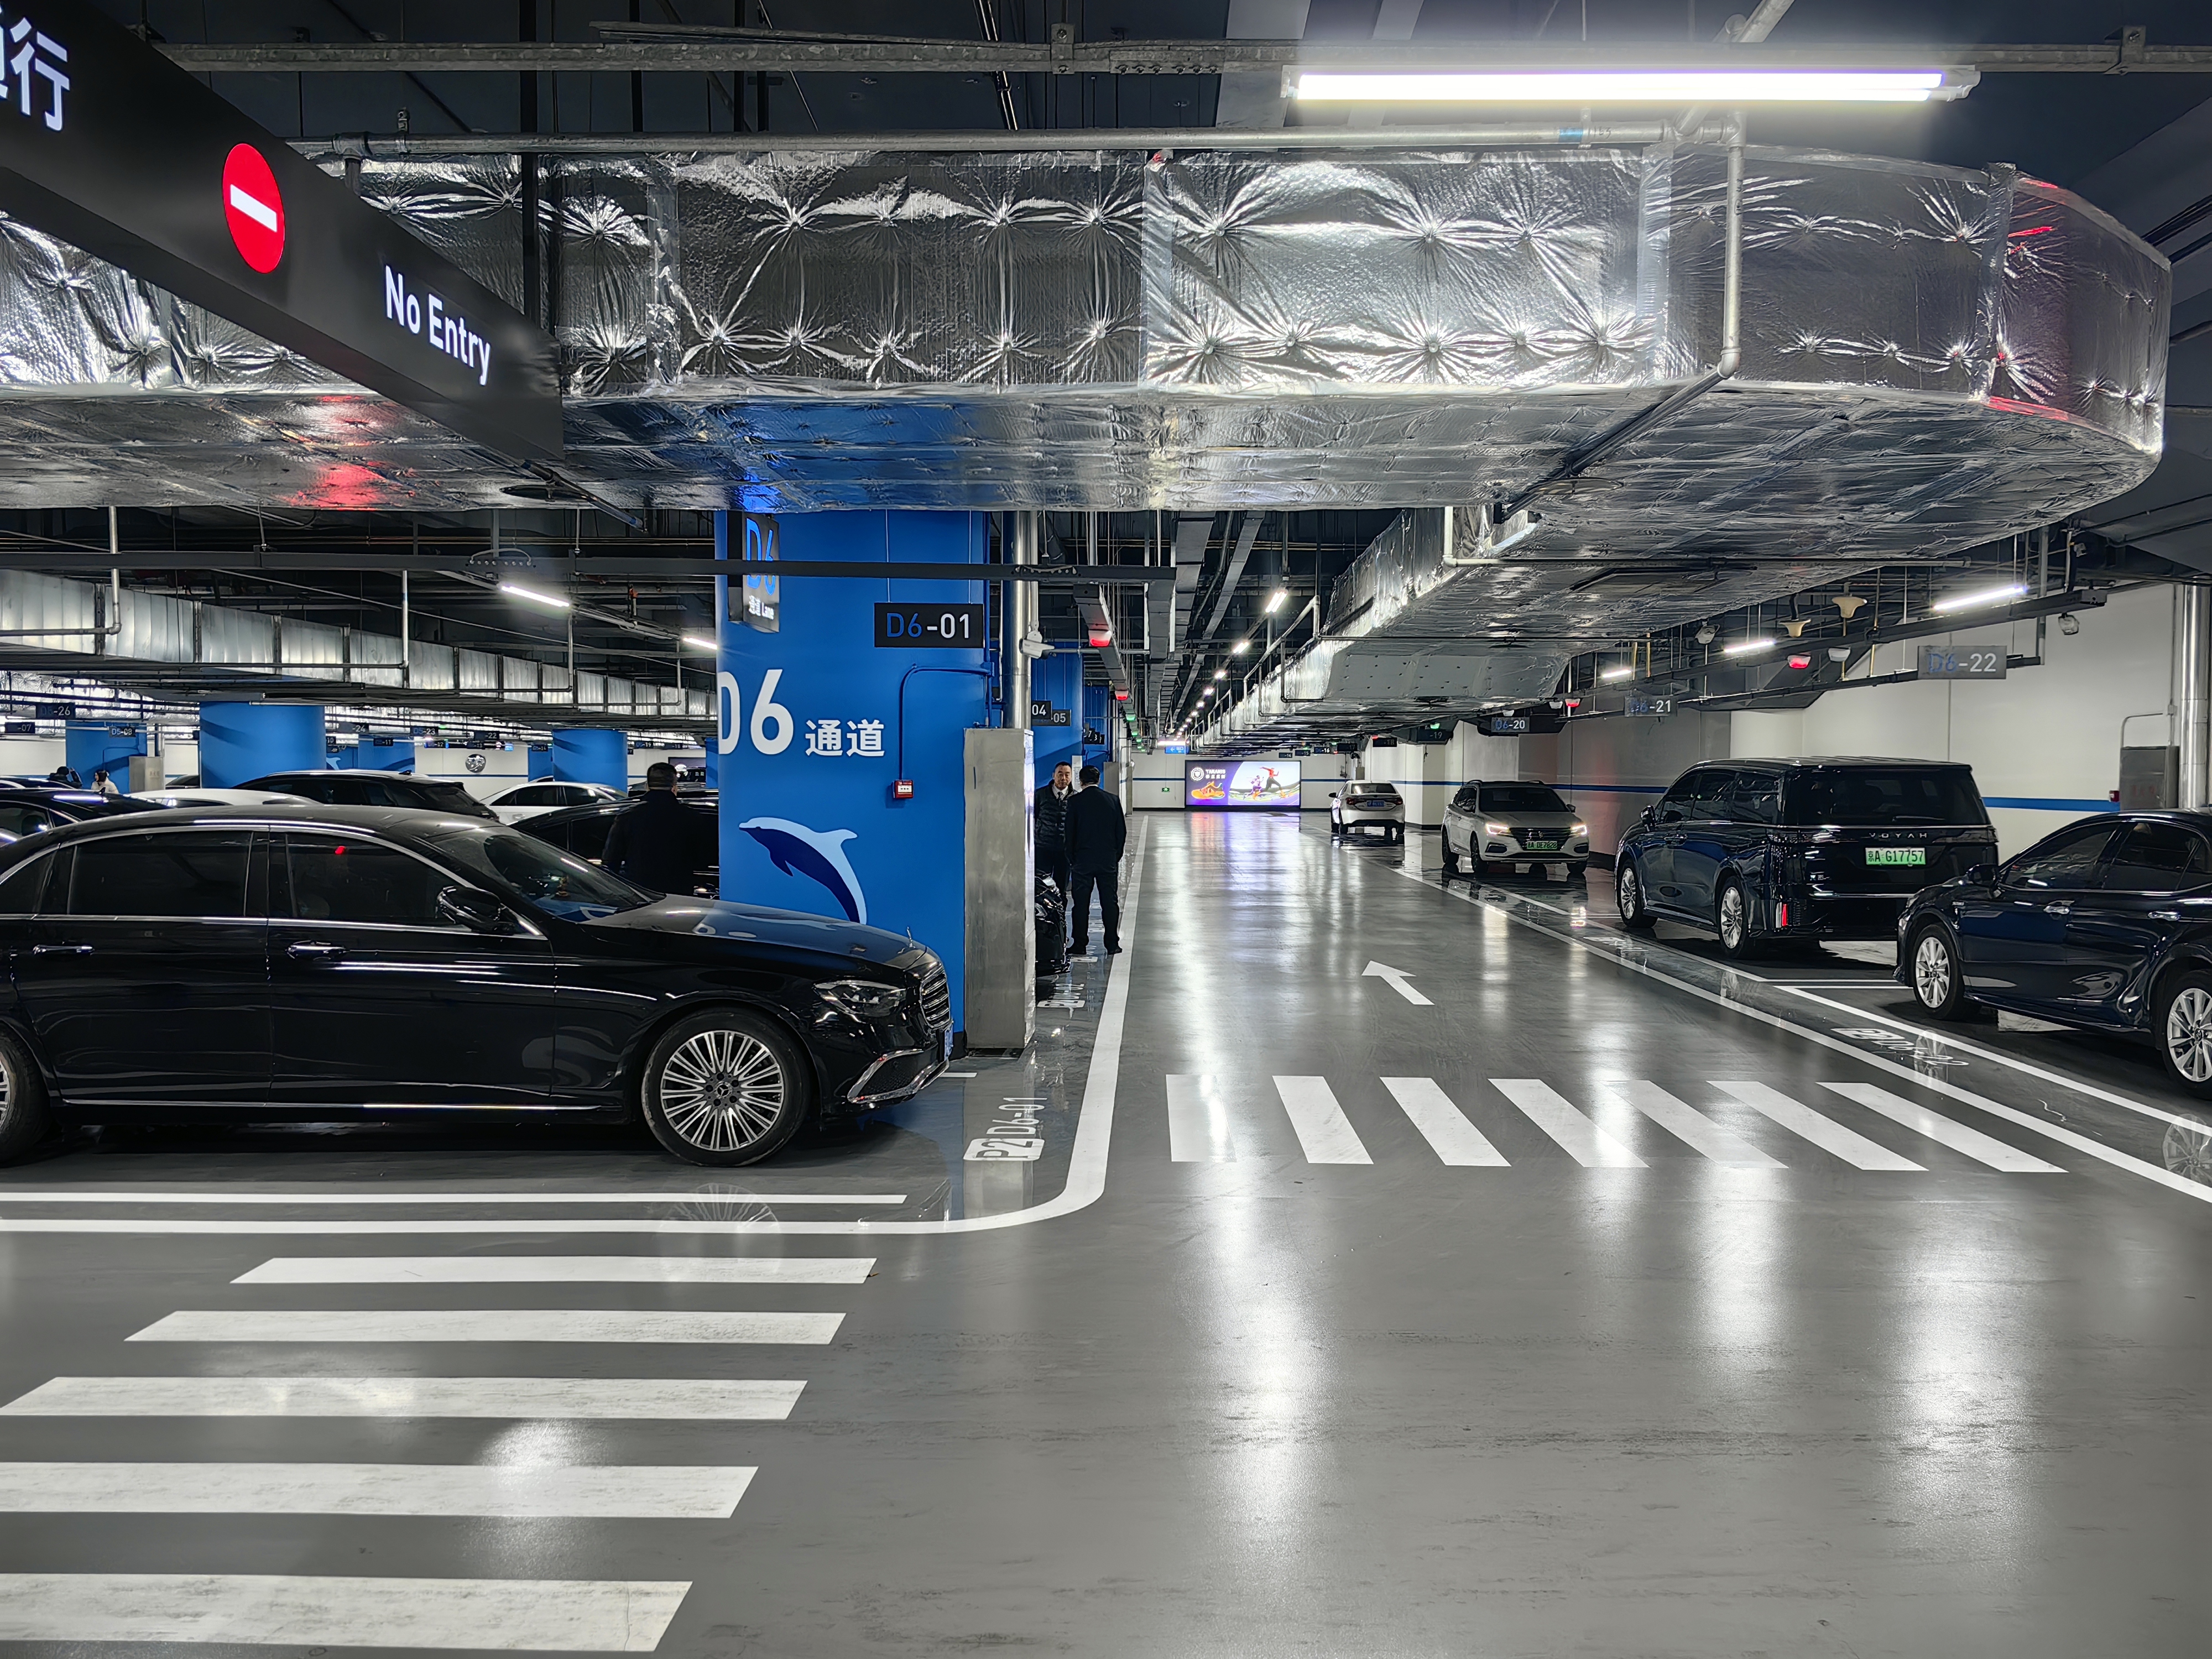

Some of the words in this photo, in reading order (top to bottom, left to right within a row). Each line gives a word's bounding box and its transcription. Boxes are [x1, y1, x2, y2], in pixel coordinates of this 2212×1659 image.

[0, 4, 70, 131] 行
[385, 264, 421, 335] No
[428, 293, 491, 386] Entry
[746, 518, 776, 596] D6
[761, 602, 774, 620] Lane
[886, 613, 969, 639] D6-01
[1929, 653, 1997, 672] D6-22
[717, 669, 794, 755] D6
[805, 718, 885, 757] 通道
[986, 1097, 1048, 1134] D6-01
